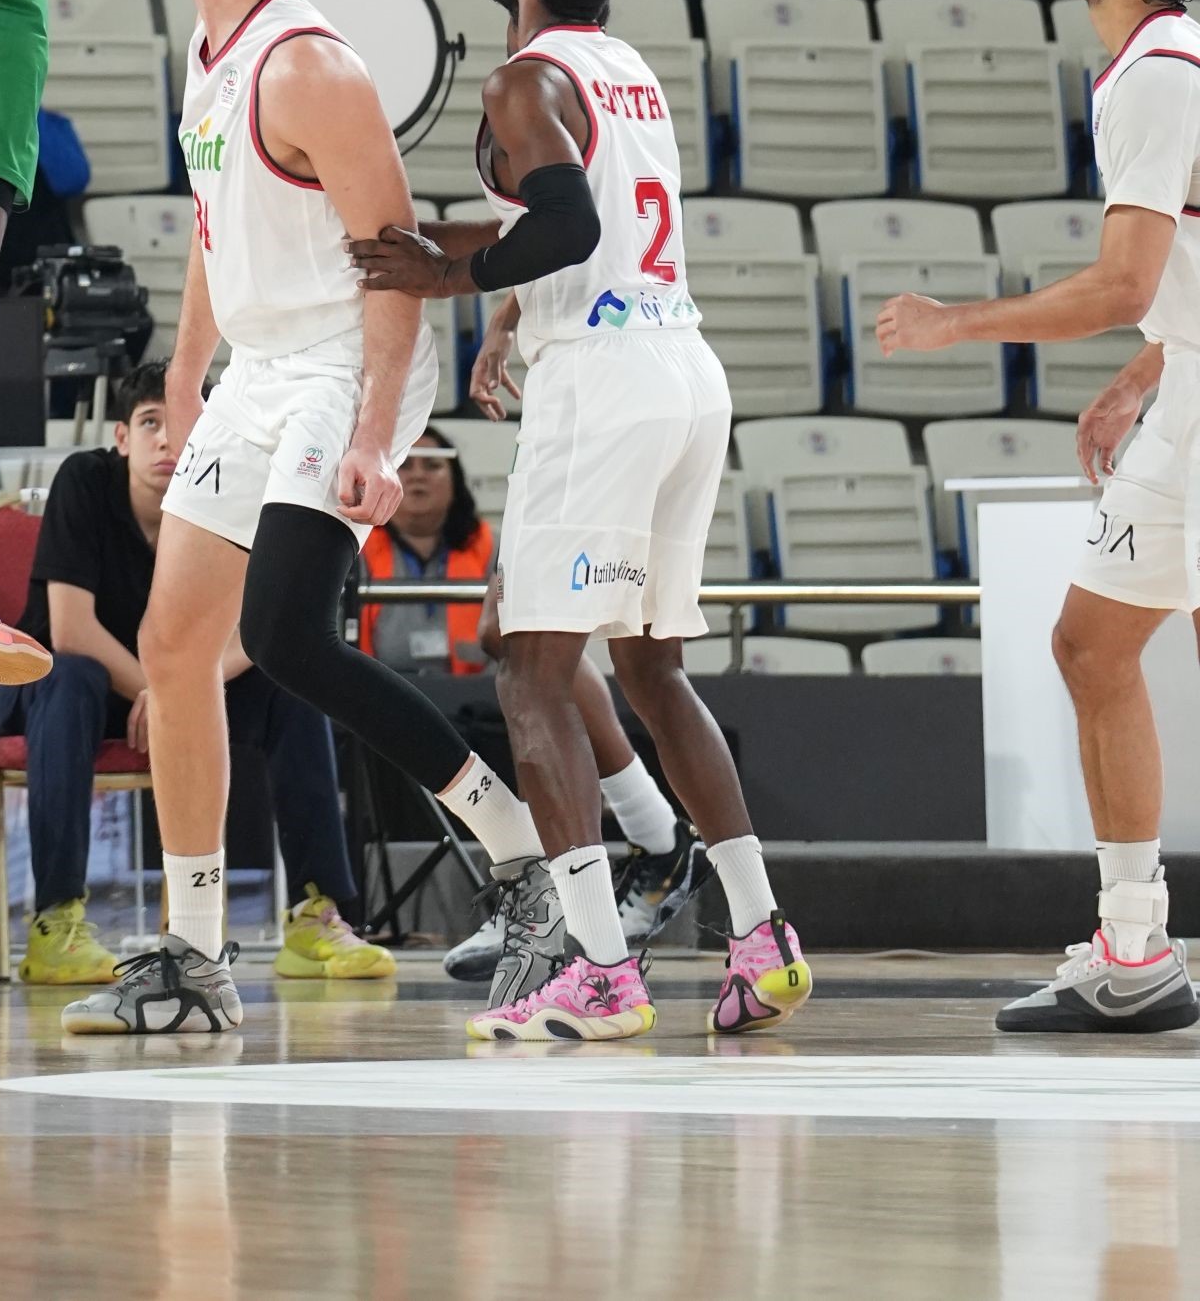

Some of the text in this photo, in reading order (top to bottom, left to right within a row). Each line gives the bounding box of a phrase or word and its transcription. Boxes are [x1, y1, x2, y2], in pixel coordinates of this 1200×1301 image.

[634, 177, 677, 285] 2
[467, 773, 493, 807] 23
[191, 867, 221, 888] 23
